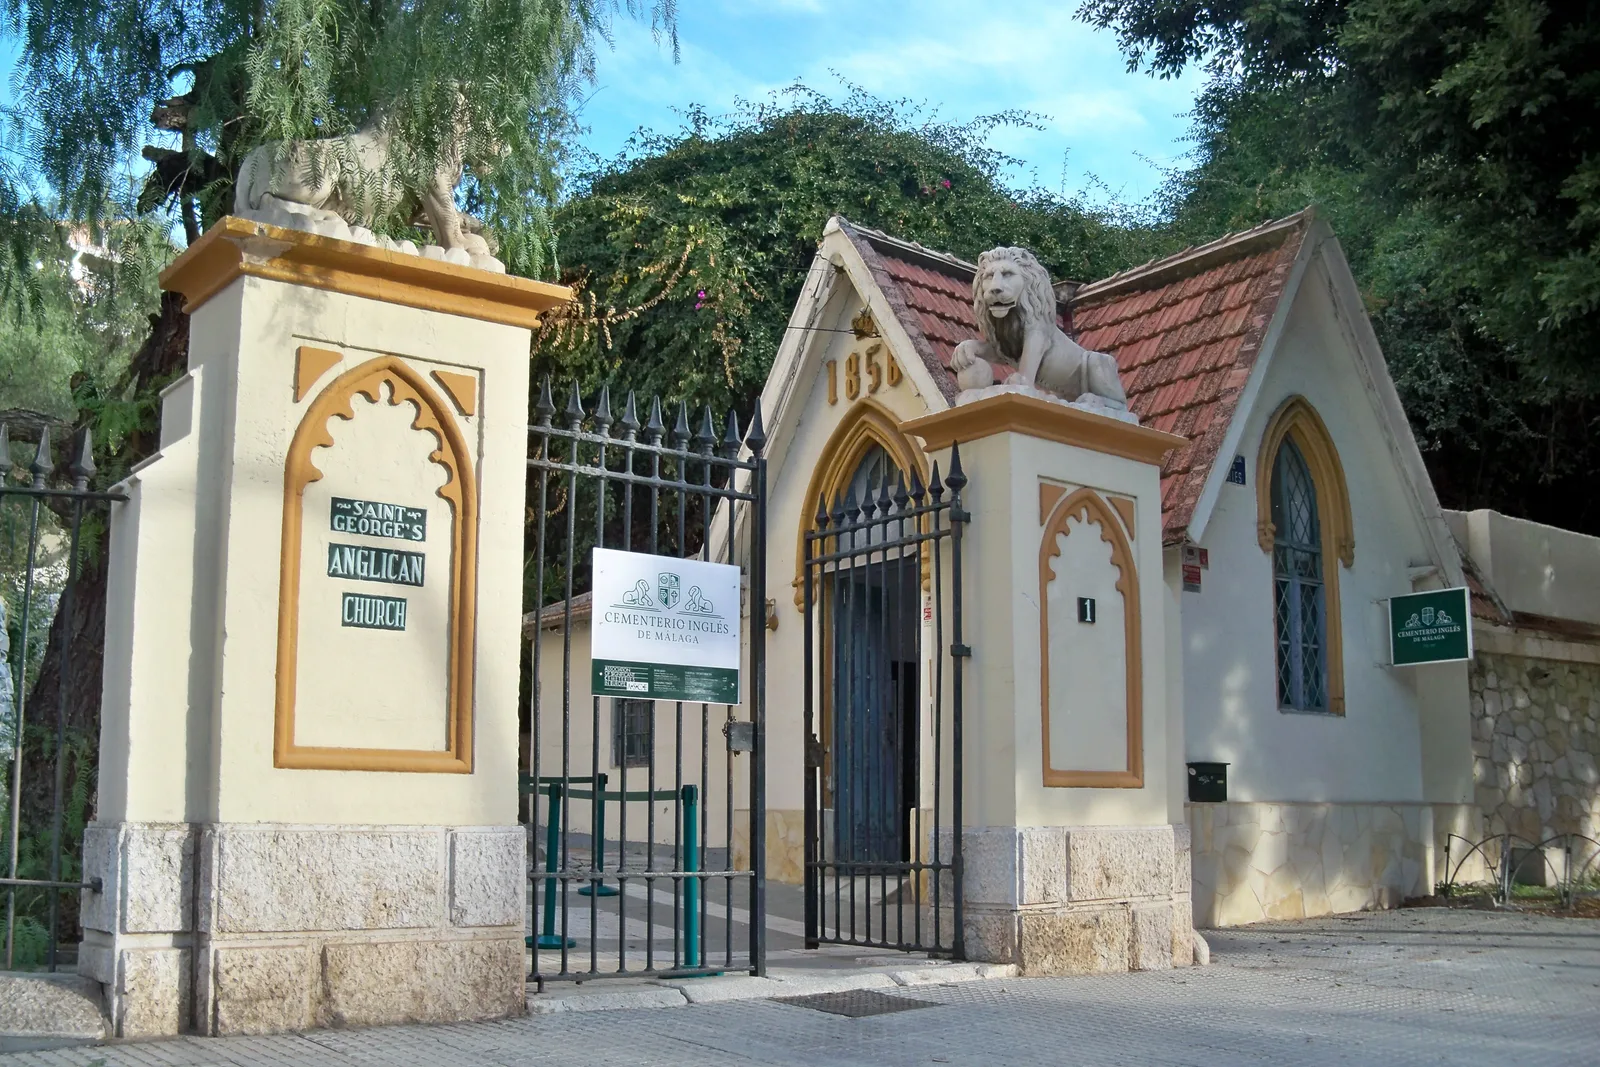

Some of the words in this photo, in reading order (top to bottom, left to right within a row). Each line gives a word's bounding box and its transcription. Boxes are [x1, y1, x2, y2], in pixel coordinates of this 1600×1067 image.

[352, 501, 407, 522] SAINT
[333, 514, 423, 541] GEORGE'S
[328, 547, 423, 584] ANGLICAN
[343, 596, 406, 628] CHURCH
[1084, 599, 1092, 622] 1
[604, 611, 685, 630] CEMENTERIO
[688, 619, 729, 635] INGLÉS
[1397, 628, 1437, 637] CEMENTERIO
[637, 629, 651, 640] DE
[655, 630, 699, 644] MÁLAGA
